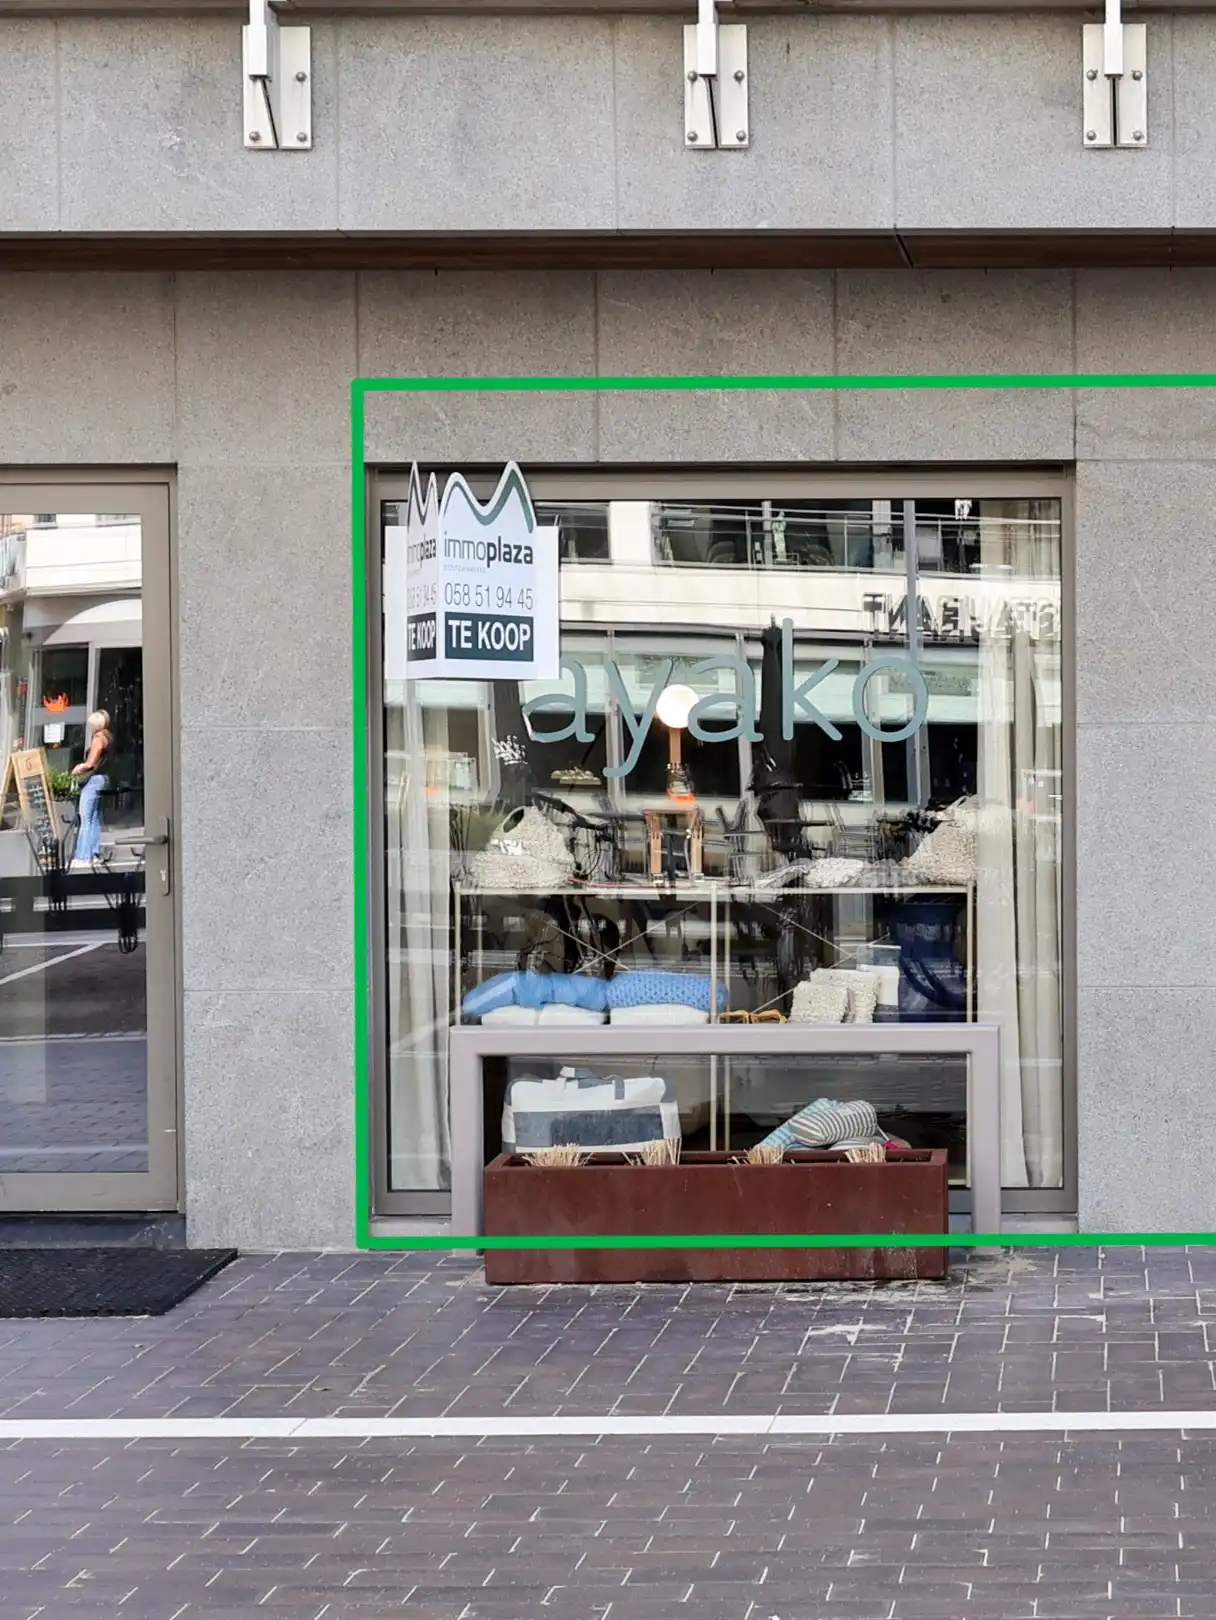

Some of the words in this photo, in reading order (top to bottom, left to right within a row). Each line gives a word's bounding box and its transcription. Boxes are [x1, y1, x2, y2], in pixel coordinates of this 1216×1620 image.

[444, 530, 534, 568] immoplaza
[444, 582, 471, 606] 058
[475, 584, 490, 608] 51
[496, 586, 513, 608] 94
[517, 587, 534, 610] 45
[408, 622, 416, 651] TE
[417, 620, 436, 650] KOOP
[448, 620, 472, 649] TE
[478, 623, 531, 651] KOOP
[521, 617, 929, 777] ayako
